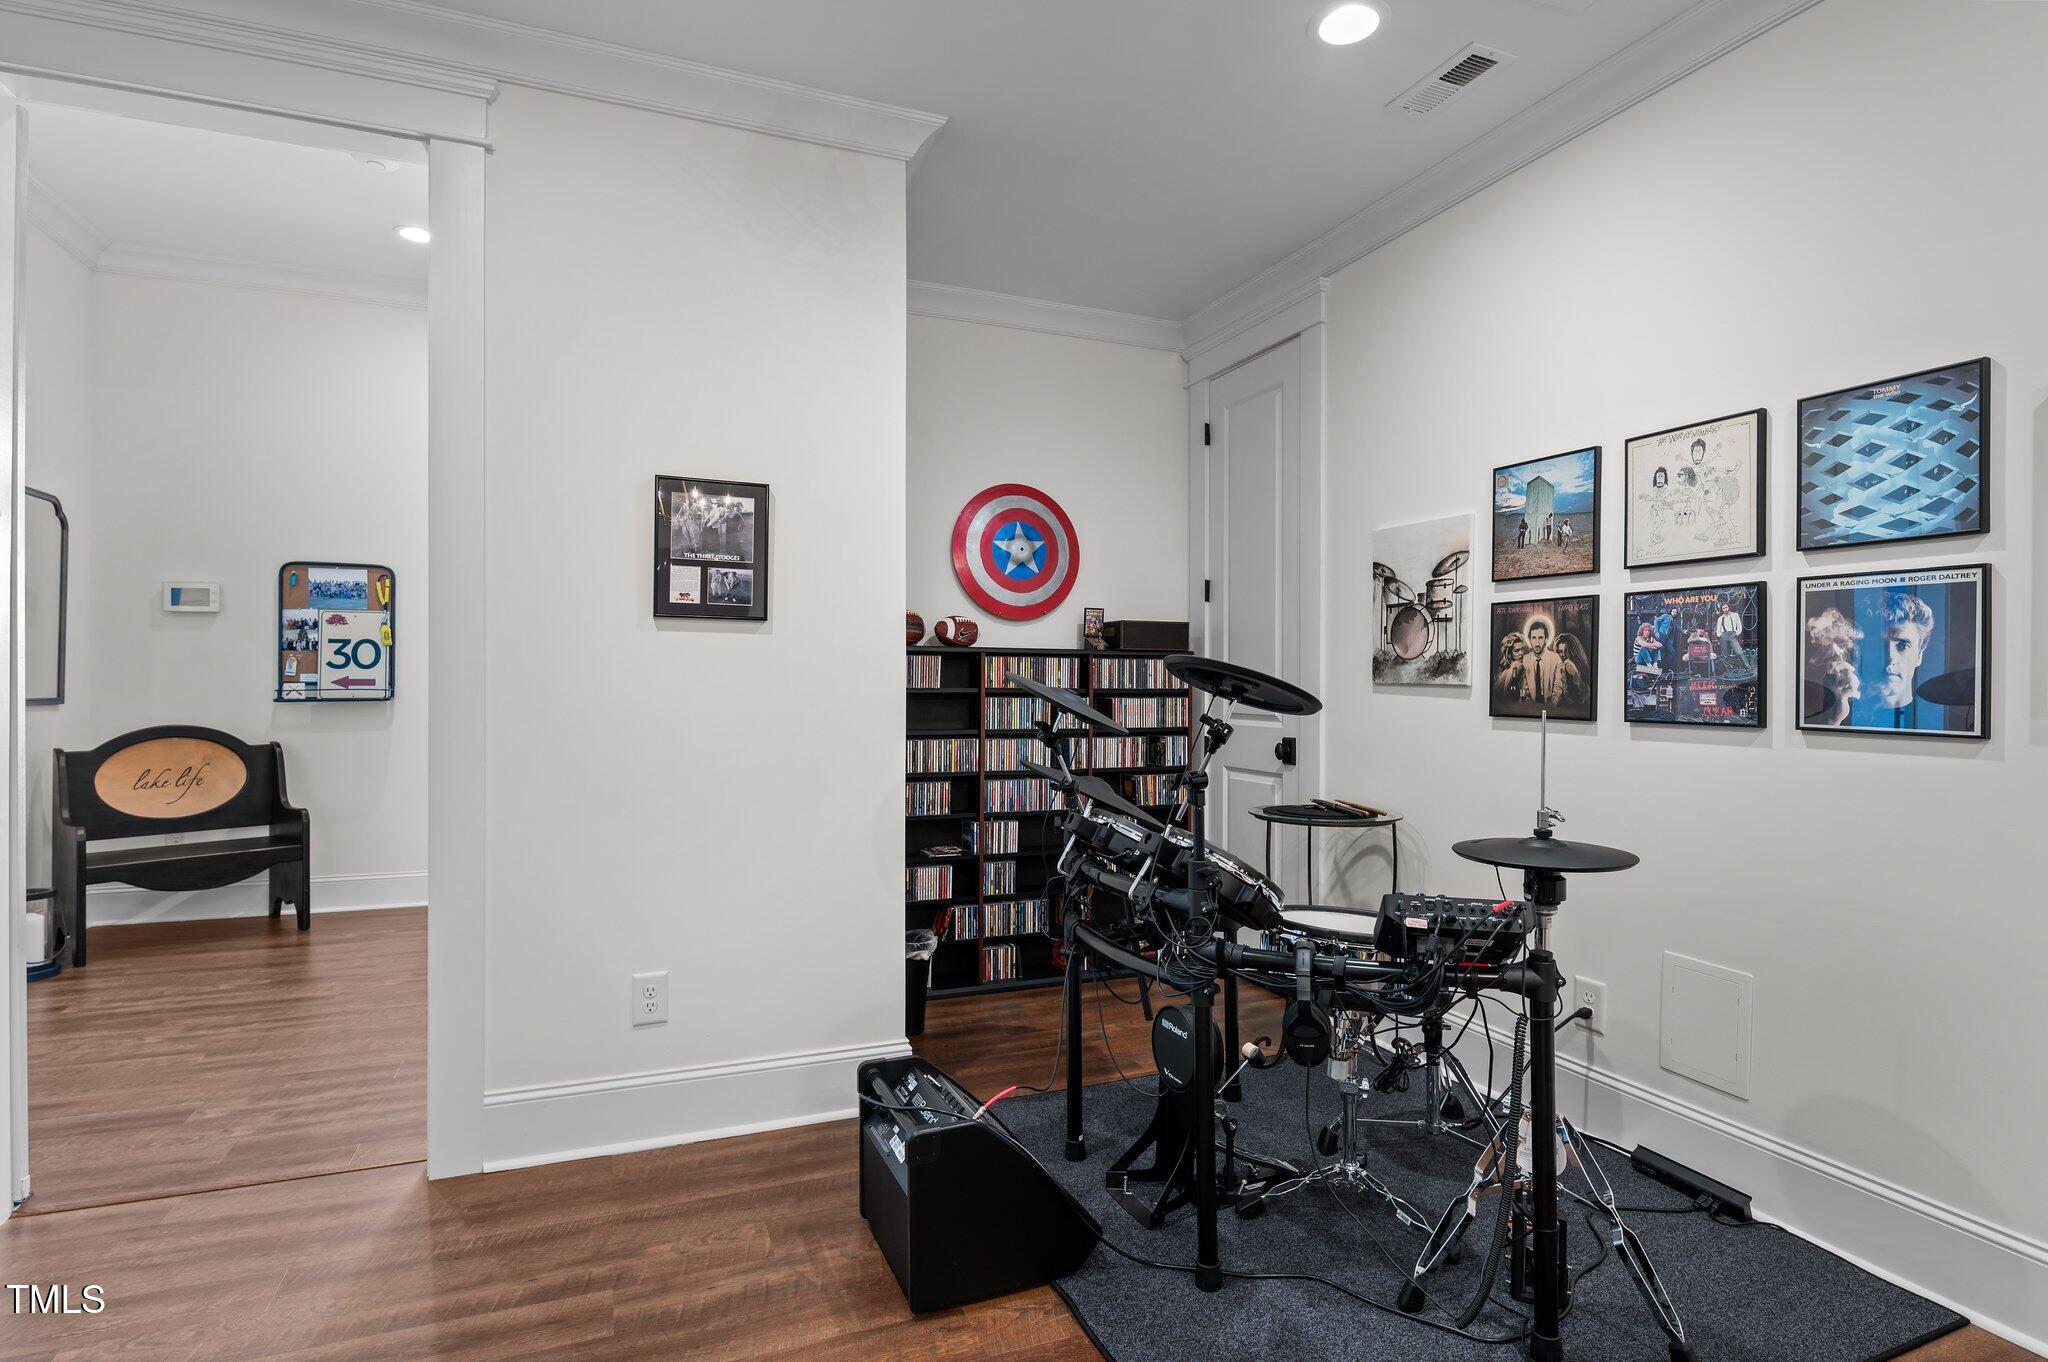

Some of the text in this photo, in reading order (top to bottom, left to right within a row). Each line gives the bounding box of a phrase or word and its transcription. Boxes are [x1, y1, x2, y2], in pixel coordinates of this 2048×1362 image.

[1873, 384, 1901, 395] TOMMY
[1840, 579, 1870, 587] RAGING
[1871, 577, 1898, 585] MOON
[1908, 575, 1937, 583] ROGER
[1938, 572, 1978, 580] DALTREY
[1664, 594, 1717, 605] WHO ARE YOU
[325, 638, 382, 670] 30
[132, 762, 210, 805] lake life
[1168, 1021, 1188, 1039] Roland
